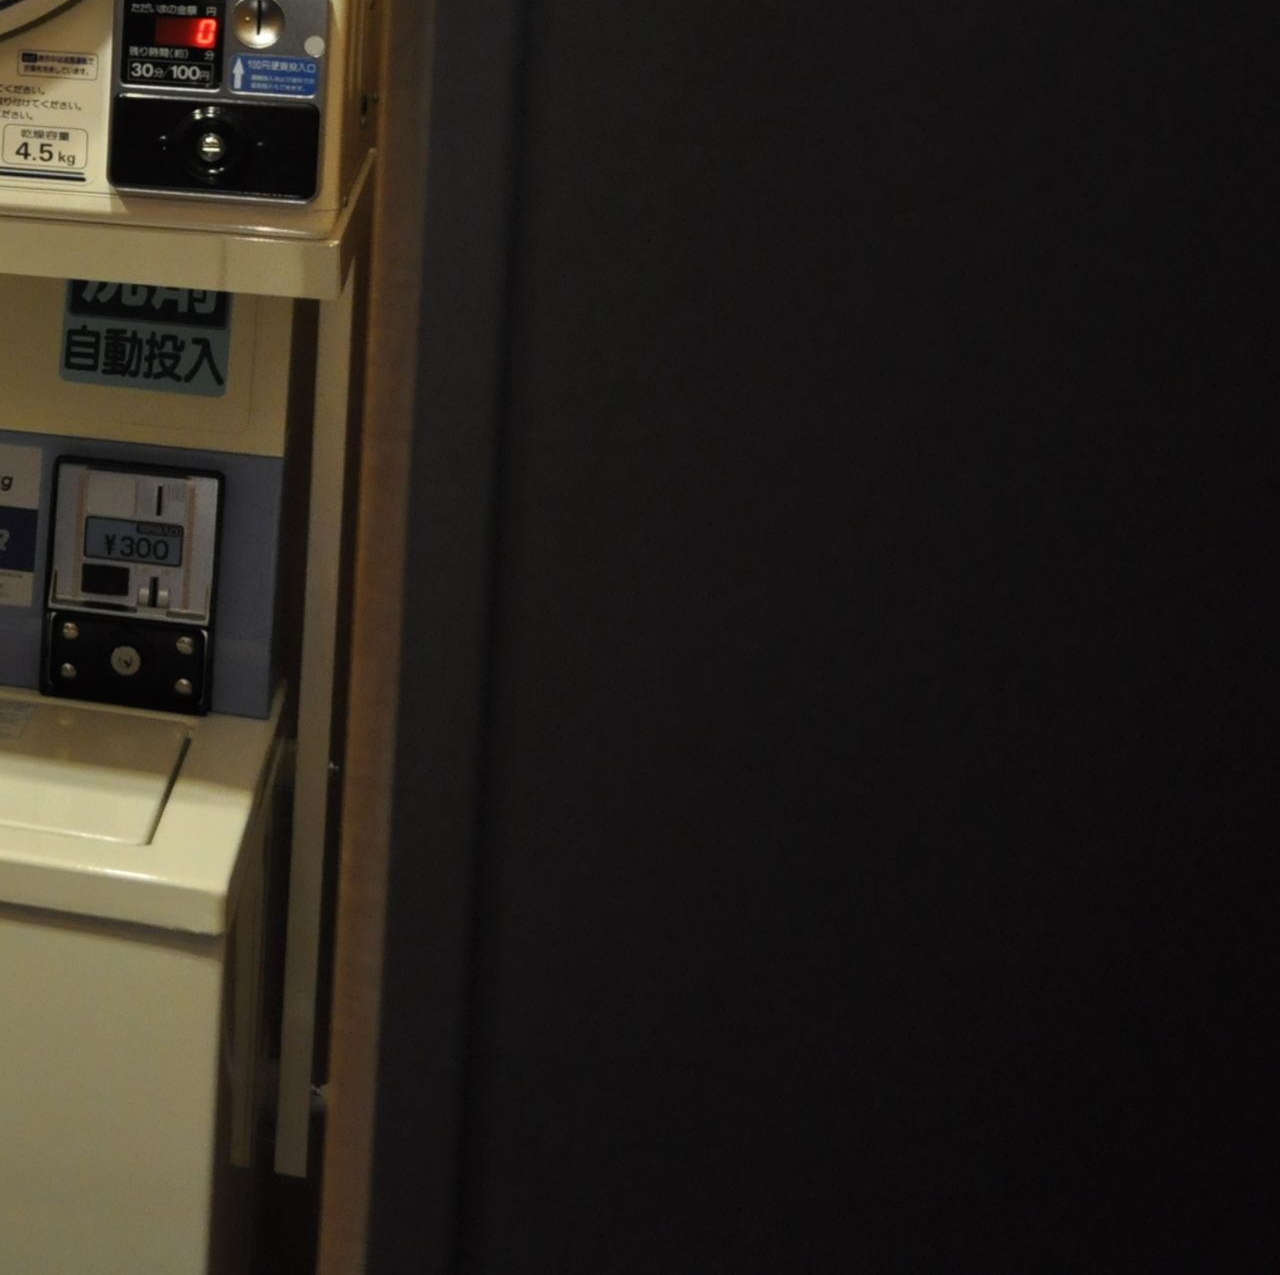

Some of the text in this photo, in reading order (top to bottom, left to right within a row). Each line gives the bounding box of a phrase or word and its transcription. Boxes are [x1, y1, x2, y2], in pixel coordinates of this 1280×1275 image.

[196, 18, 217, 45] 0
[15, 141, 76, 166] 4.5 kg
[64, 325, 225, 386] 自動投入
[104, 533, 170, 561] ¥300
